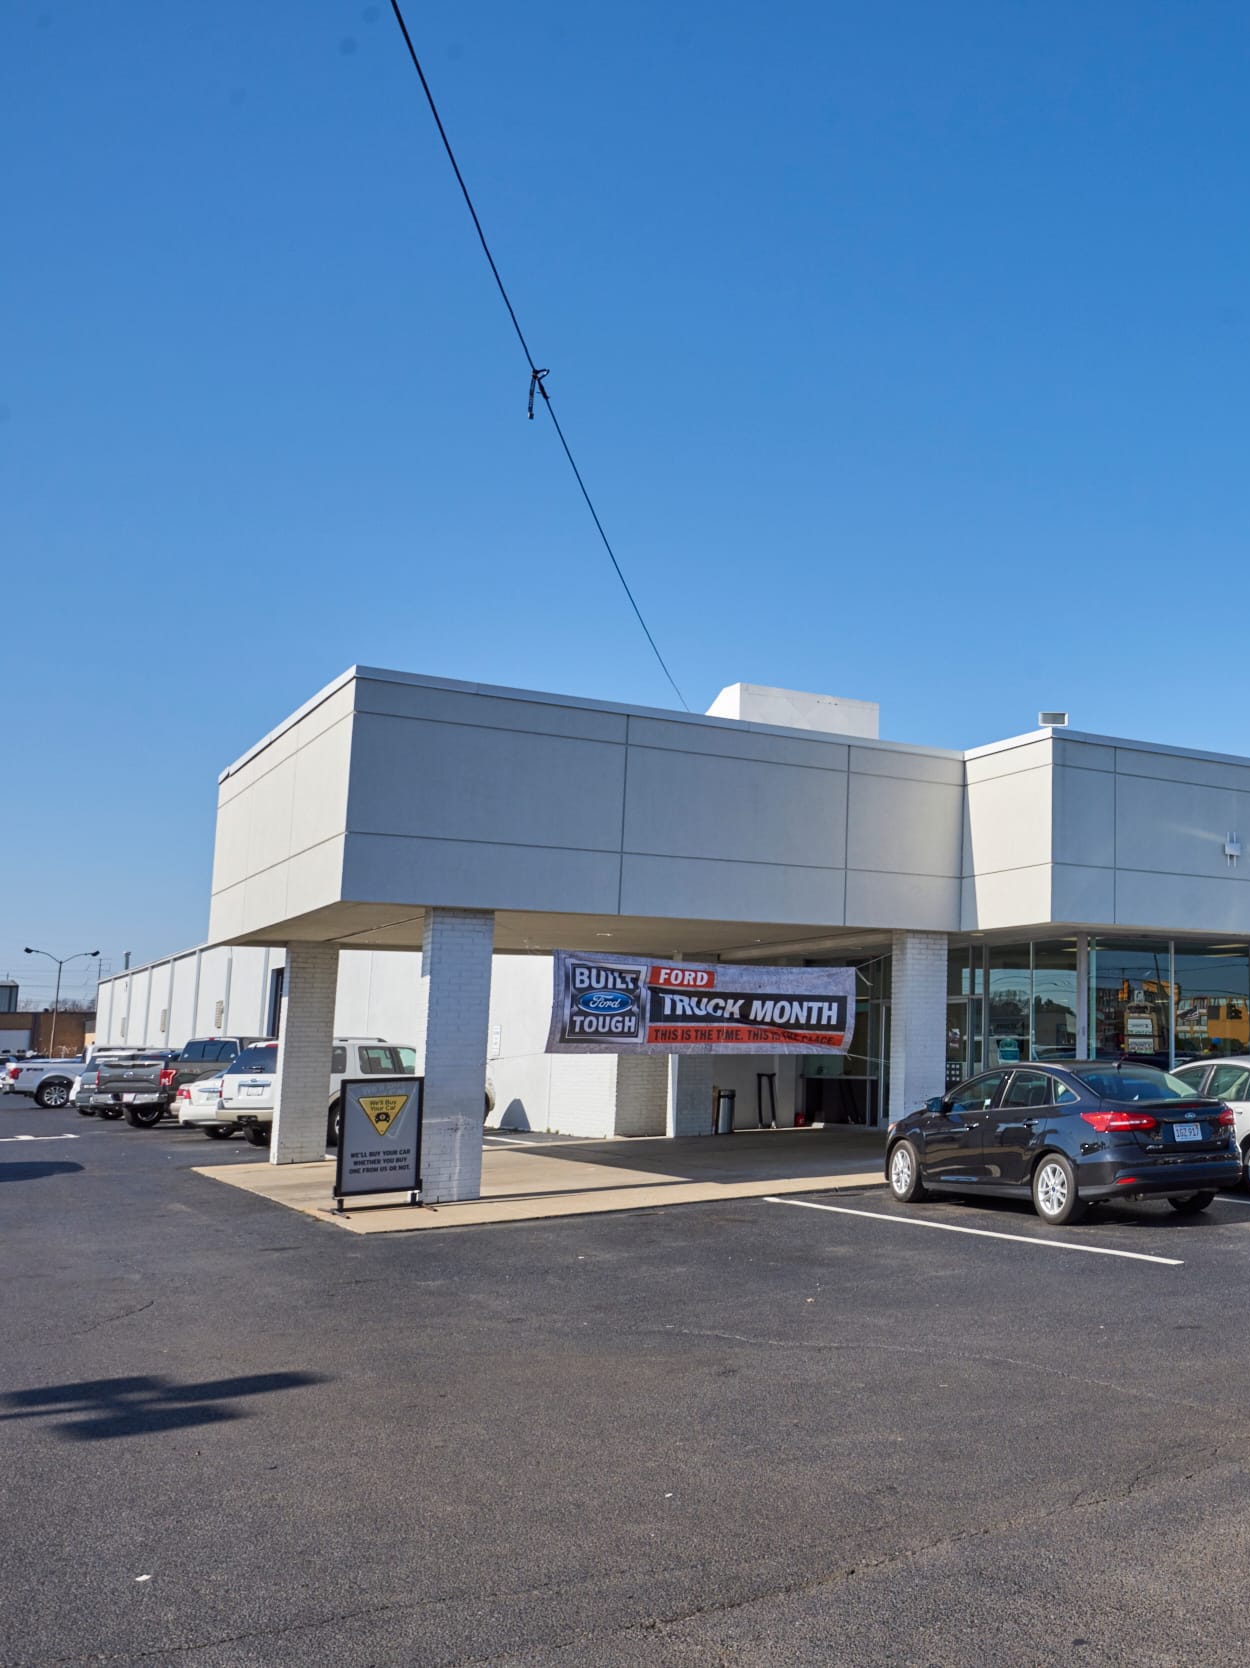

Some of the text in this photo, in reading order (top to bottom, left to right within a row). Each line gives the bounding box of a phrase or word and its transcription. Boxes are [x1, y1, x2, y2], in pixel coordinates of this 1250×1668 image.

[575, 967, 637, 989] BUILT
[659, 968, 709, 986] FORD
[589, 994, 622, 1009] Ford
[658, 993, 838, 1025] TRUCK MONTH
[572, 1015, 636, 1033] TOUGH
[654, 1028, 678, 1040] THIS
[680, 1028, 692, 1040] IS
[694, 1029, 713, 1040] THE
[747, 1029, 769, 1041] THIS
